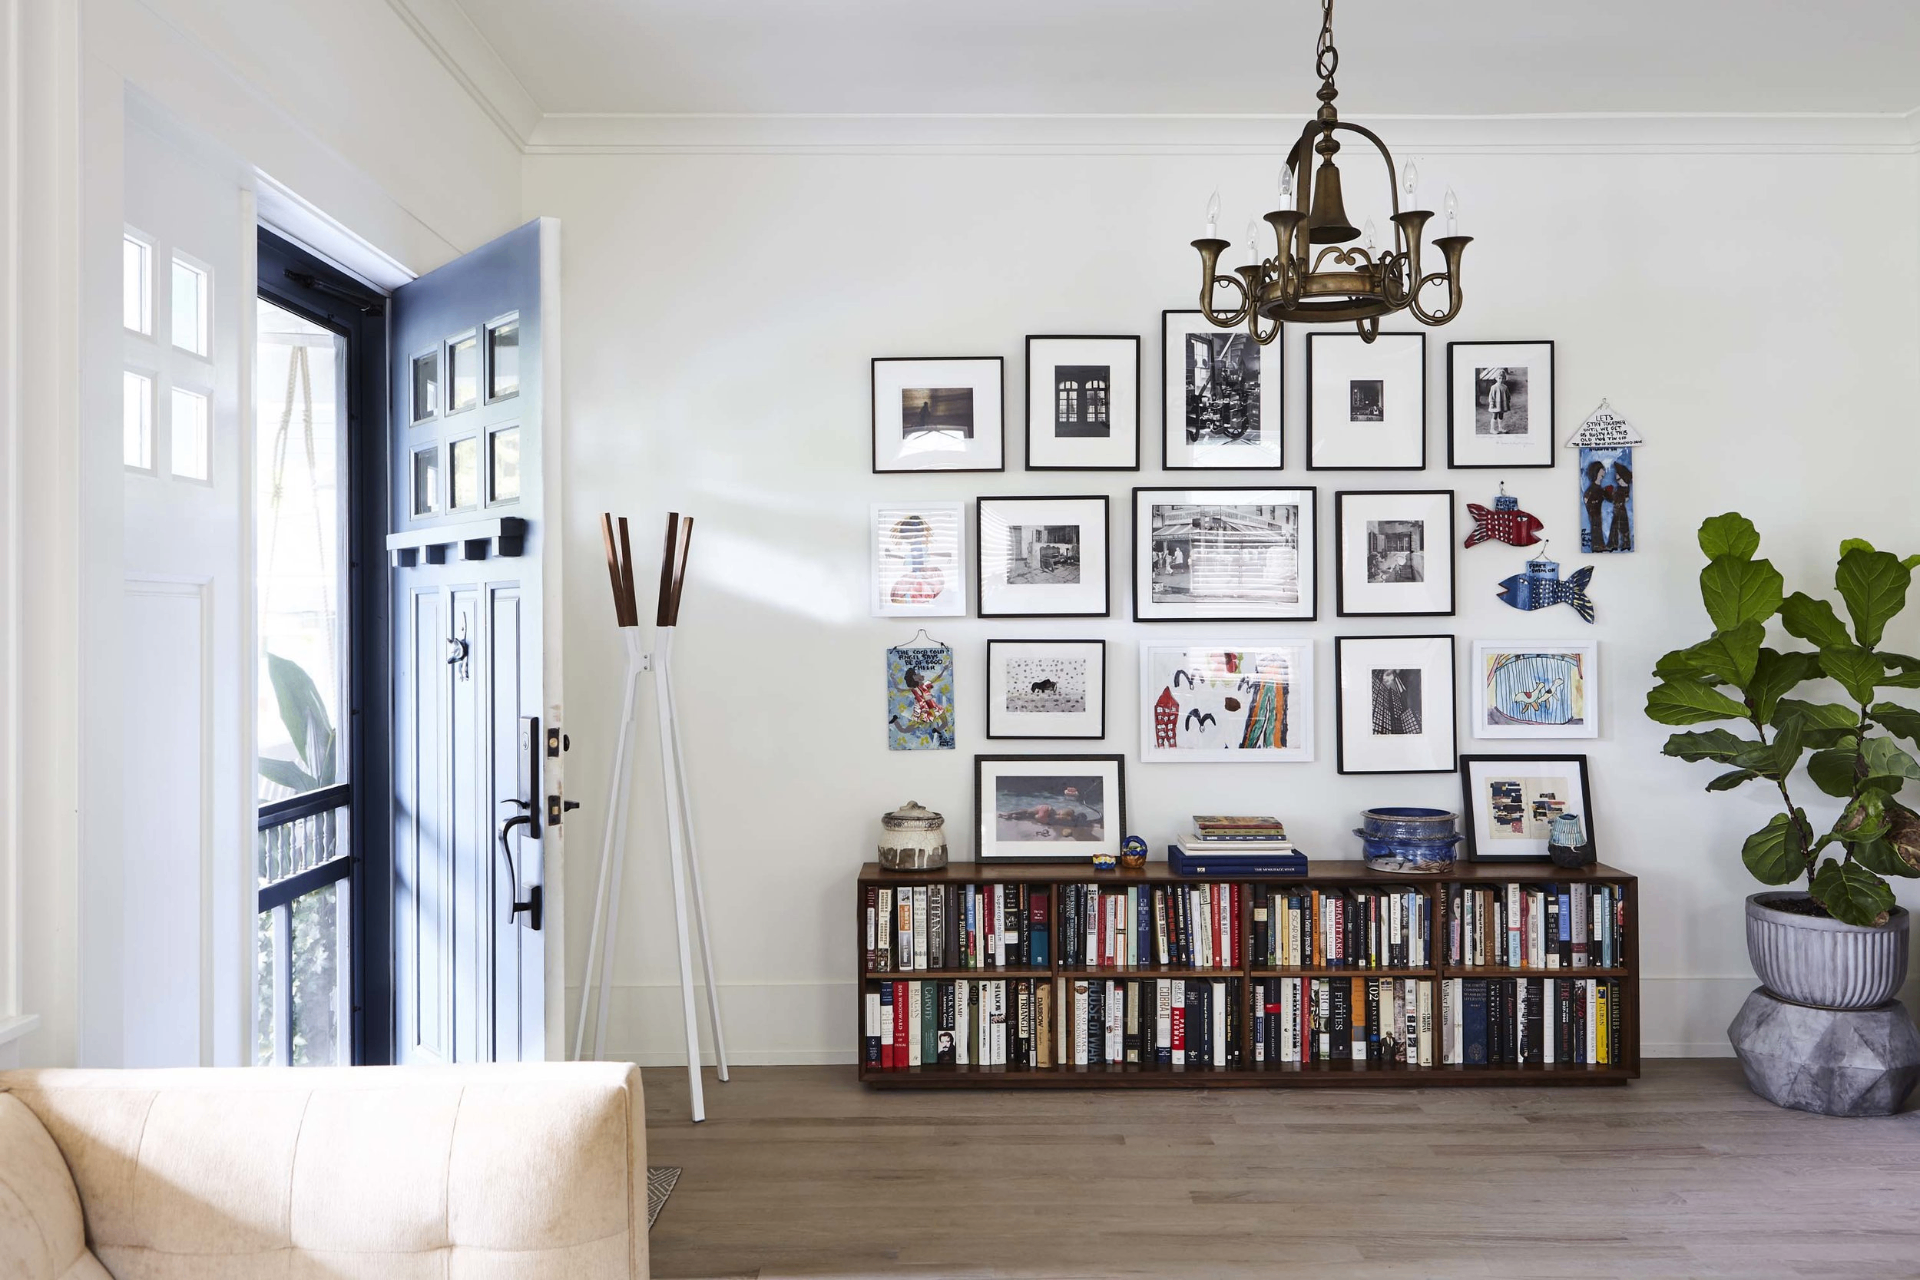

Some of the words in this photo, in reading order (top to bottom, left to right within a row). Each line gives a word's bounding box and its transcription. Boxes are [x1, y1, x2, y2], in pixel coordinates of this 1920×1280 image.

[932, 895, 940, 931] TITAN
[925, 987, 933, 1020] CAPOTE
[1089, 980, 1100, 1020] HOUSE
[1160, 987, 1169, 1012] COBRA
[1369, 982, 1378, 1001] 102
[1561, 983, 1569, 999] FDR
[1089, 1037, 1100, 1063] WAR
